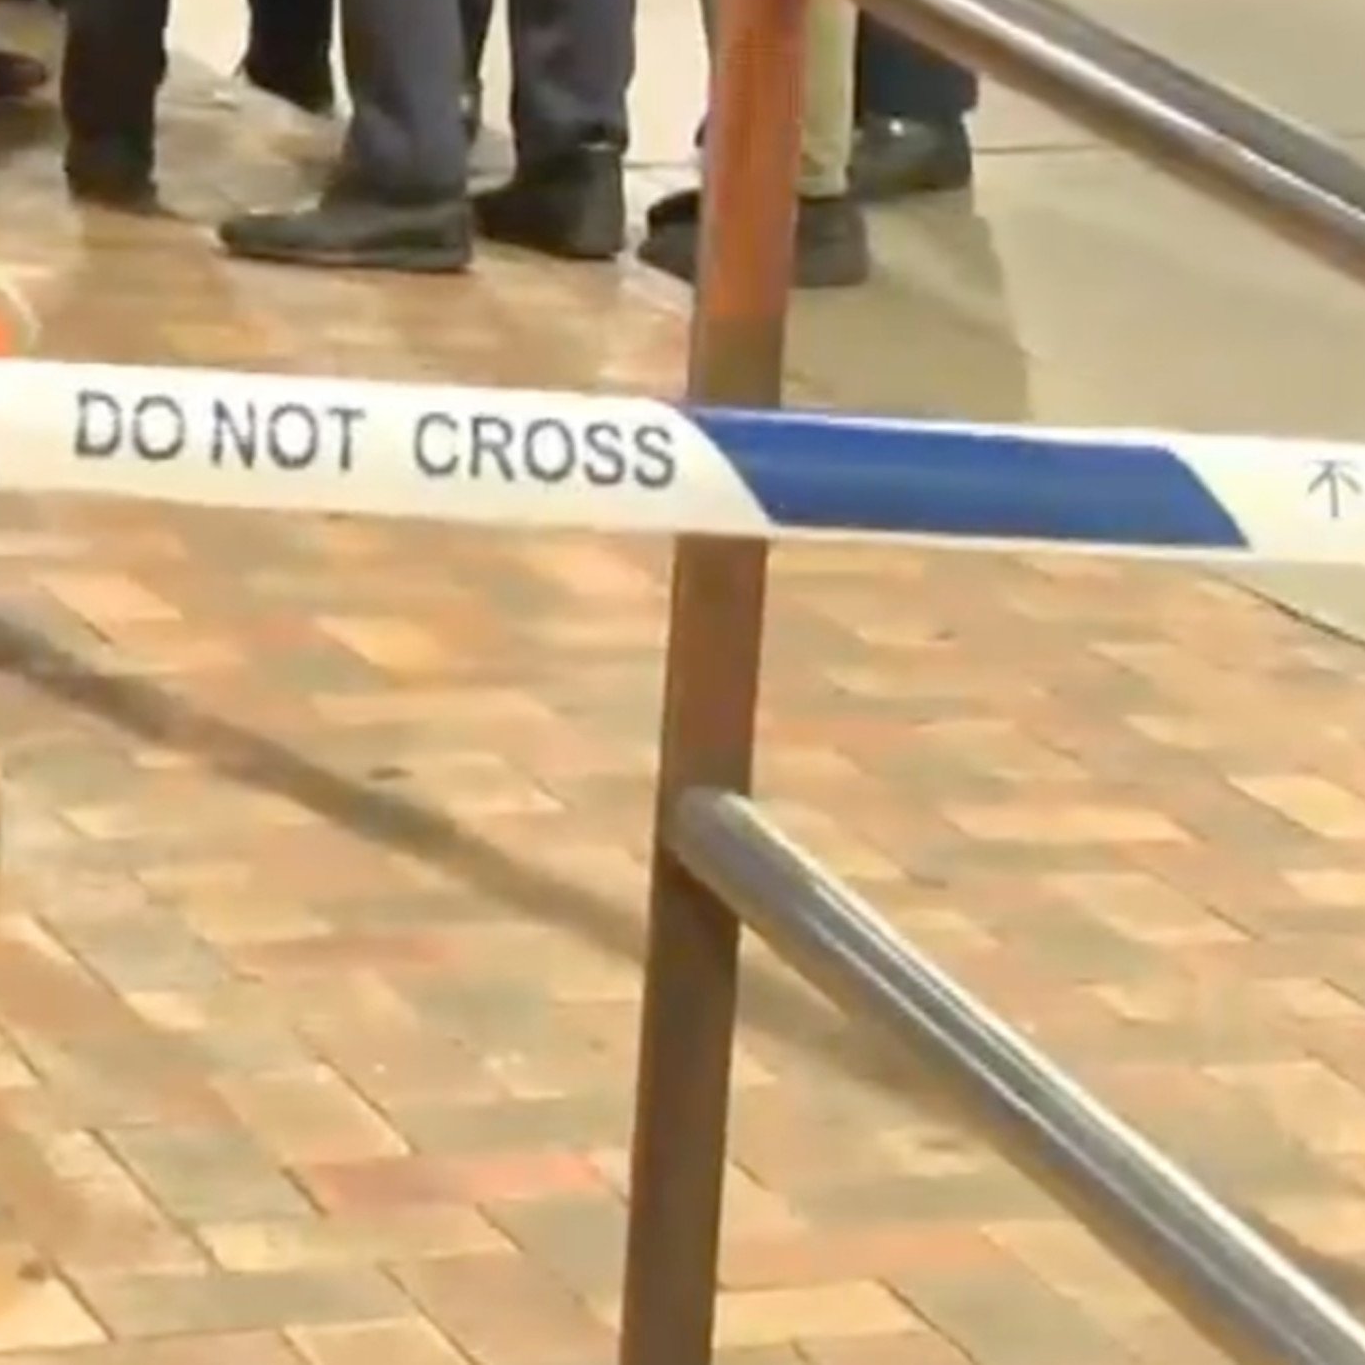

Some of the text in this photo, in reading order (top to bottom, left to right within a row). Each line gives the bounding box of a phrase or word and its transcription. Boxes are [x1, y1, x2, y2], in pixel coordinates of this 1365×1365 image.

[73, 389, 677, 490] DO NOT CROSS
